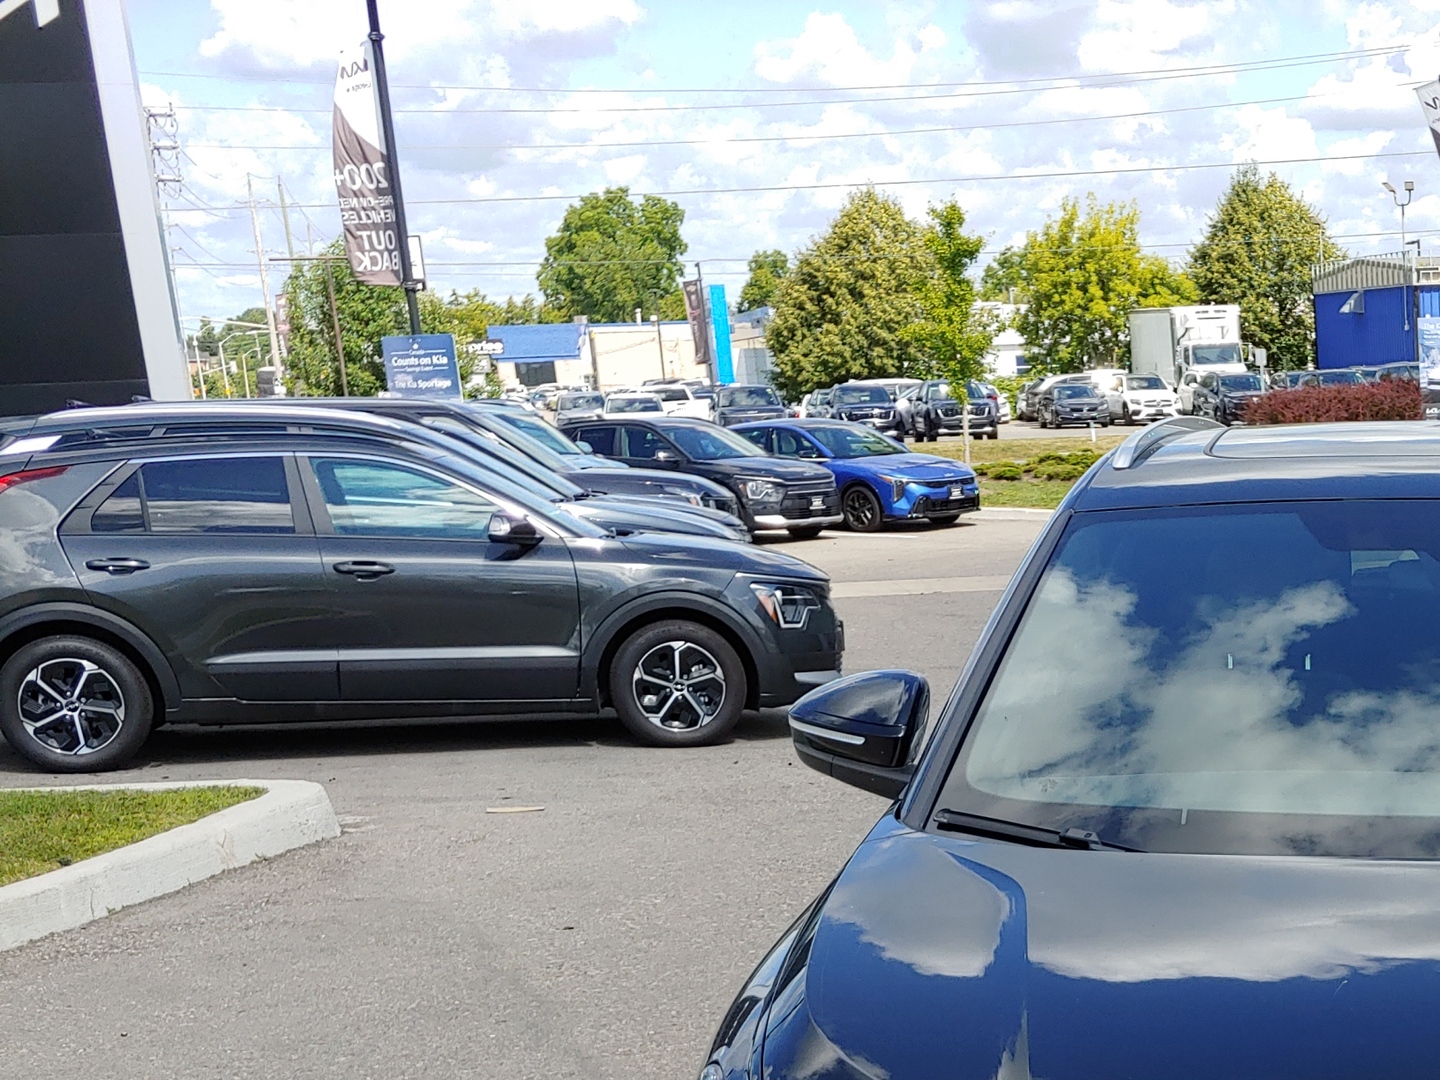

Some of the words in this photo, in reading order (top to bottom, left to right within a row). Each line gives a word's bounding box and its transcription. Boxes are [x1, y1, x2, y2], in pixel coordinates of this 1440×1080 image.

[392, 356, 419, 366] Counts
[419, 357, 431, 365] on
[432, 354, 448, 365] Kia
[417, 379, 452, 389] Sportage
